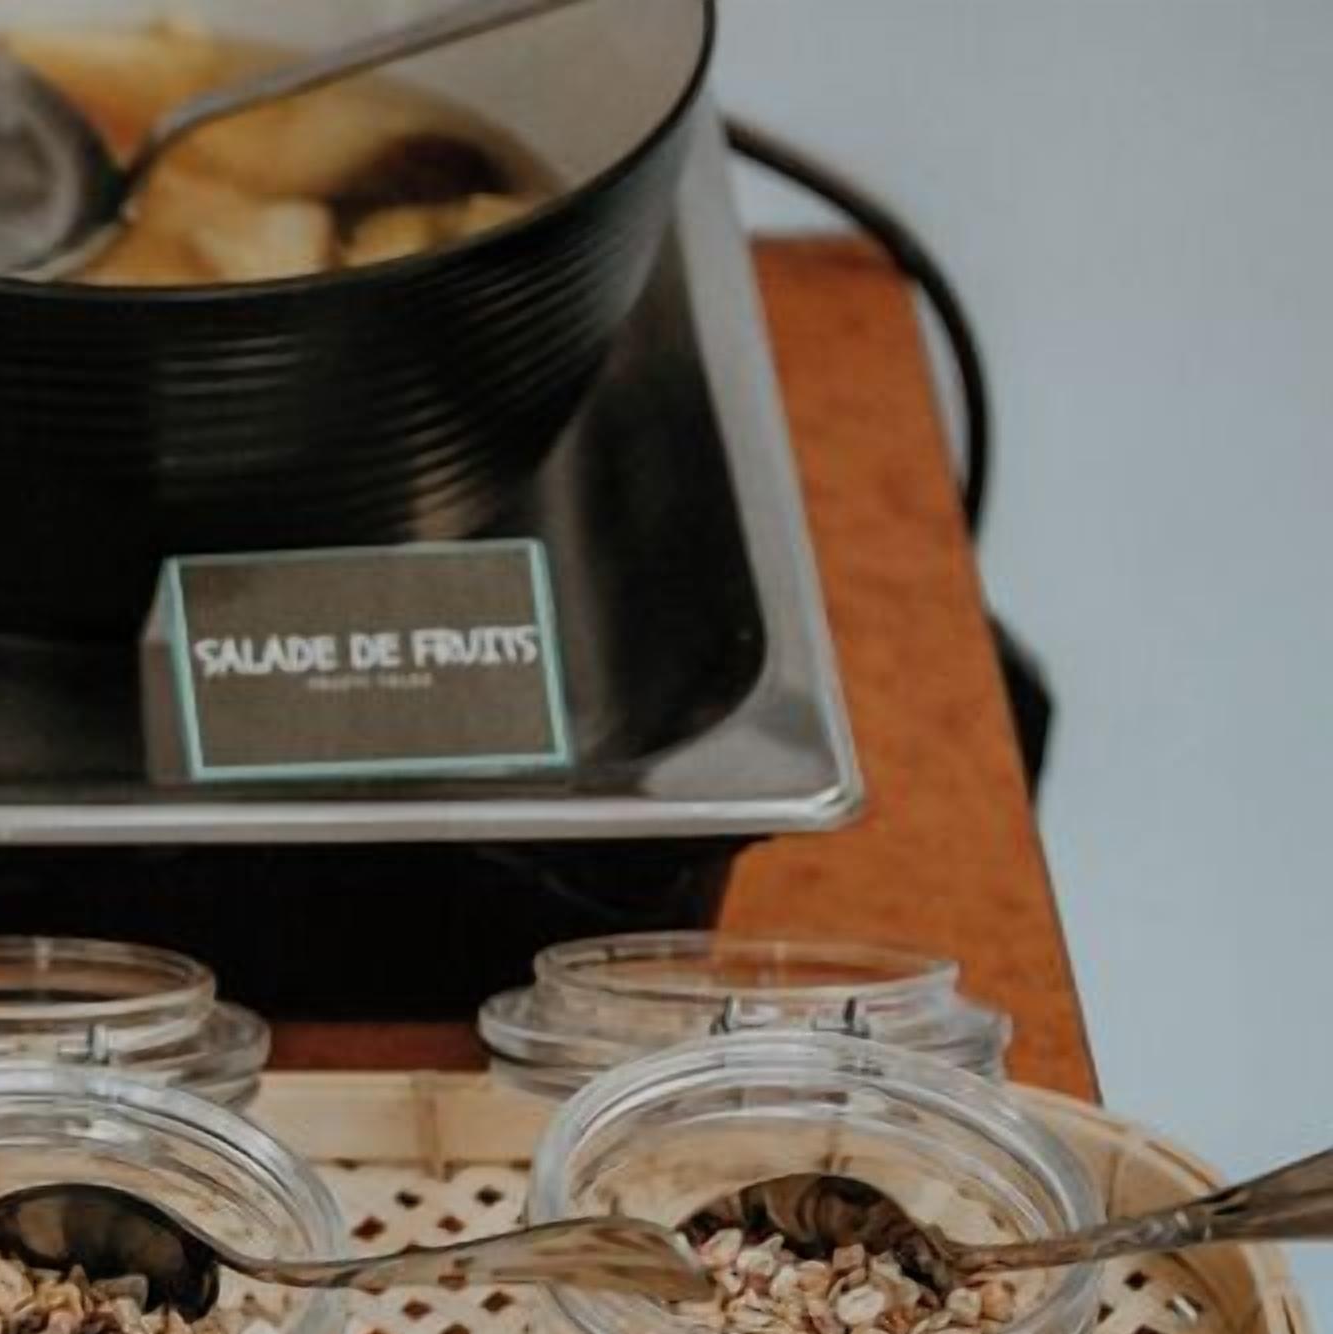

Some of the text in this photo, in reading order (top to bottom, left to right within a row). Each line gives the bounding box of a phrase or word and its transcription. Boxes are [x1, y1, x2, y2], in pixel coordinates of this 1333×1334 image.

[193, 625, 538, 677] SALADE DE FRUITS
